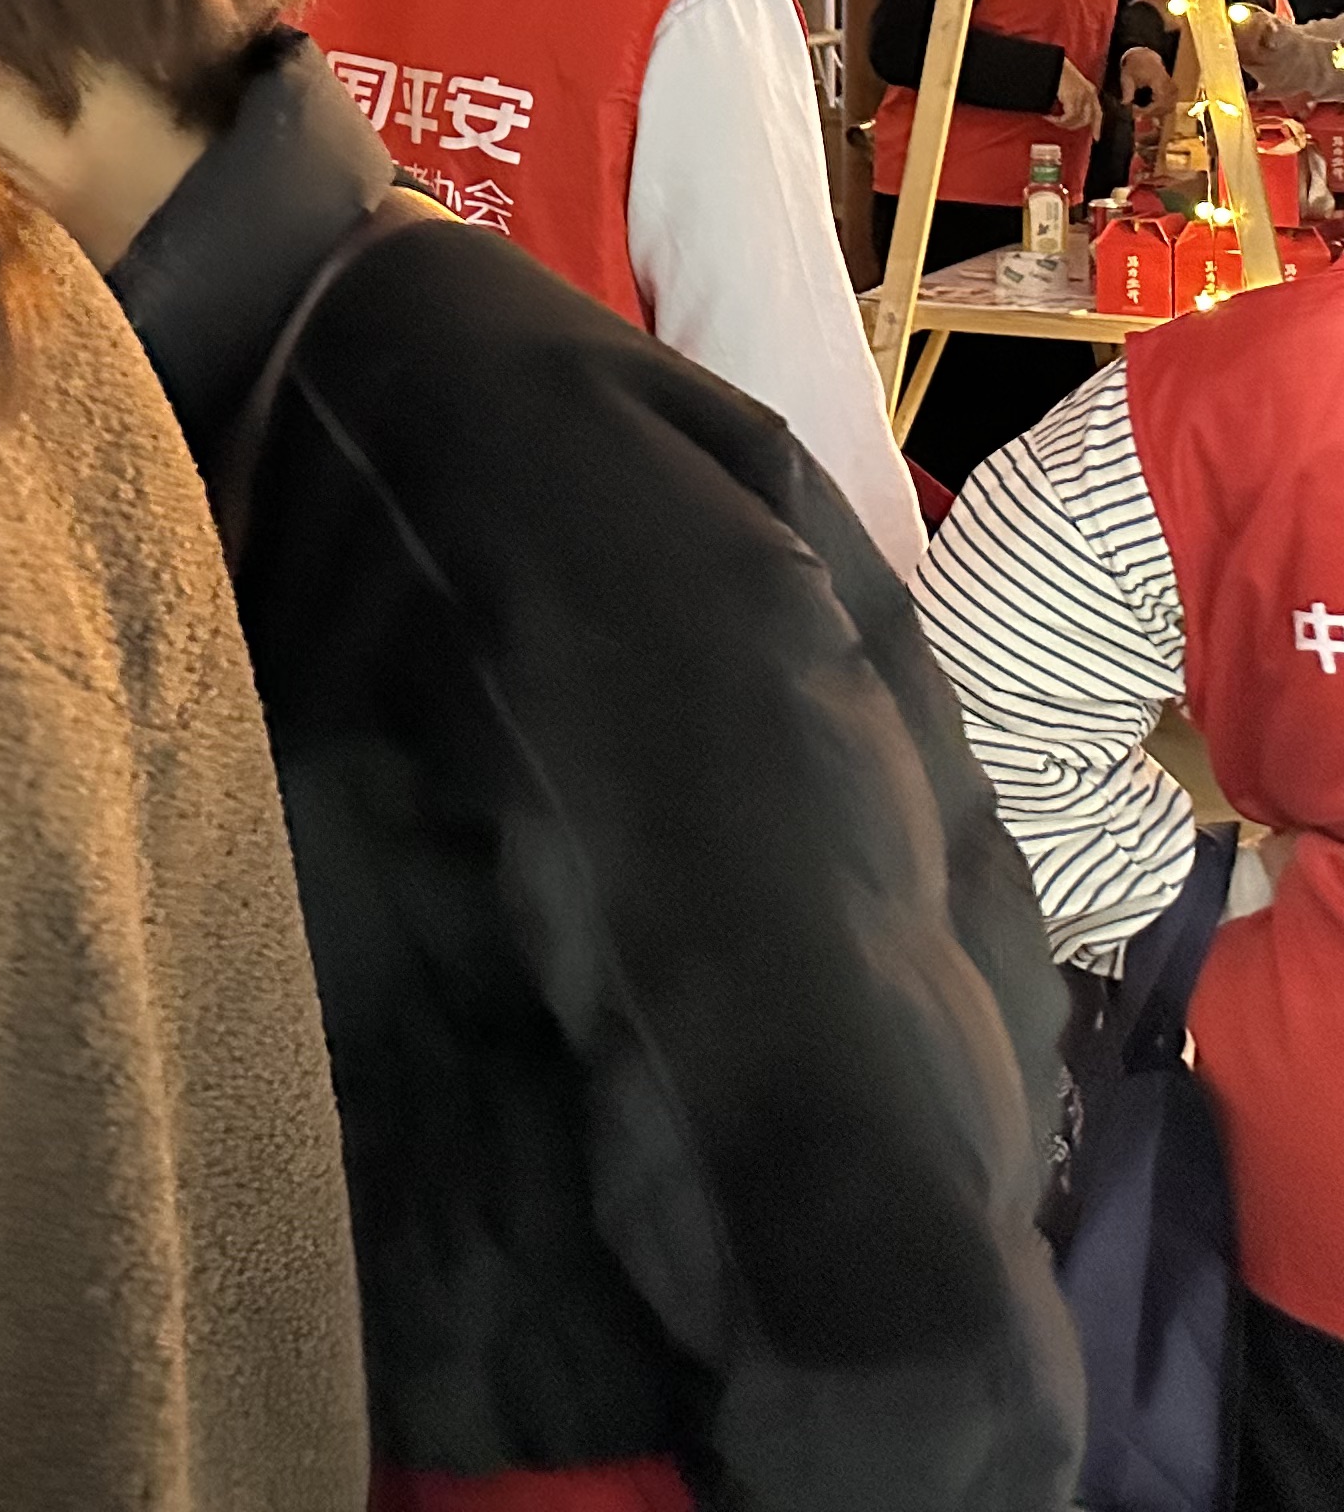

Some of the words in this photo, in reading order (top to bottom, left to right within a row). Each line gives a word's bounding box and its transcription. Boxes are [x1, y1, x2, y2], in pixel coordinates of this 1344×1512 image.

[326, 50, 534, 165] 国平安
[1293, 601, 1344, 674] 中
